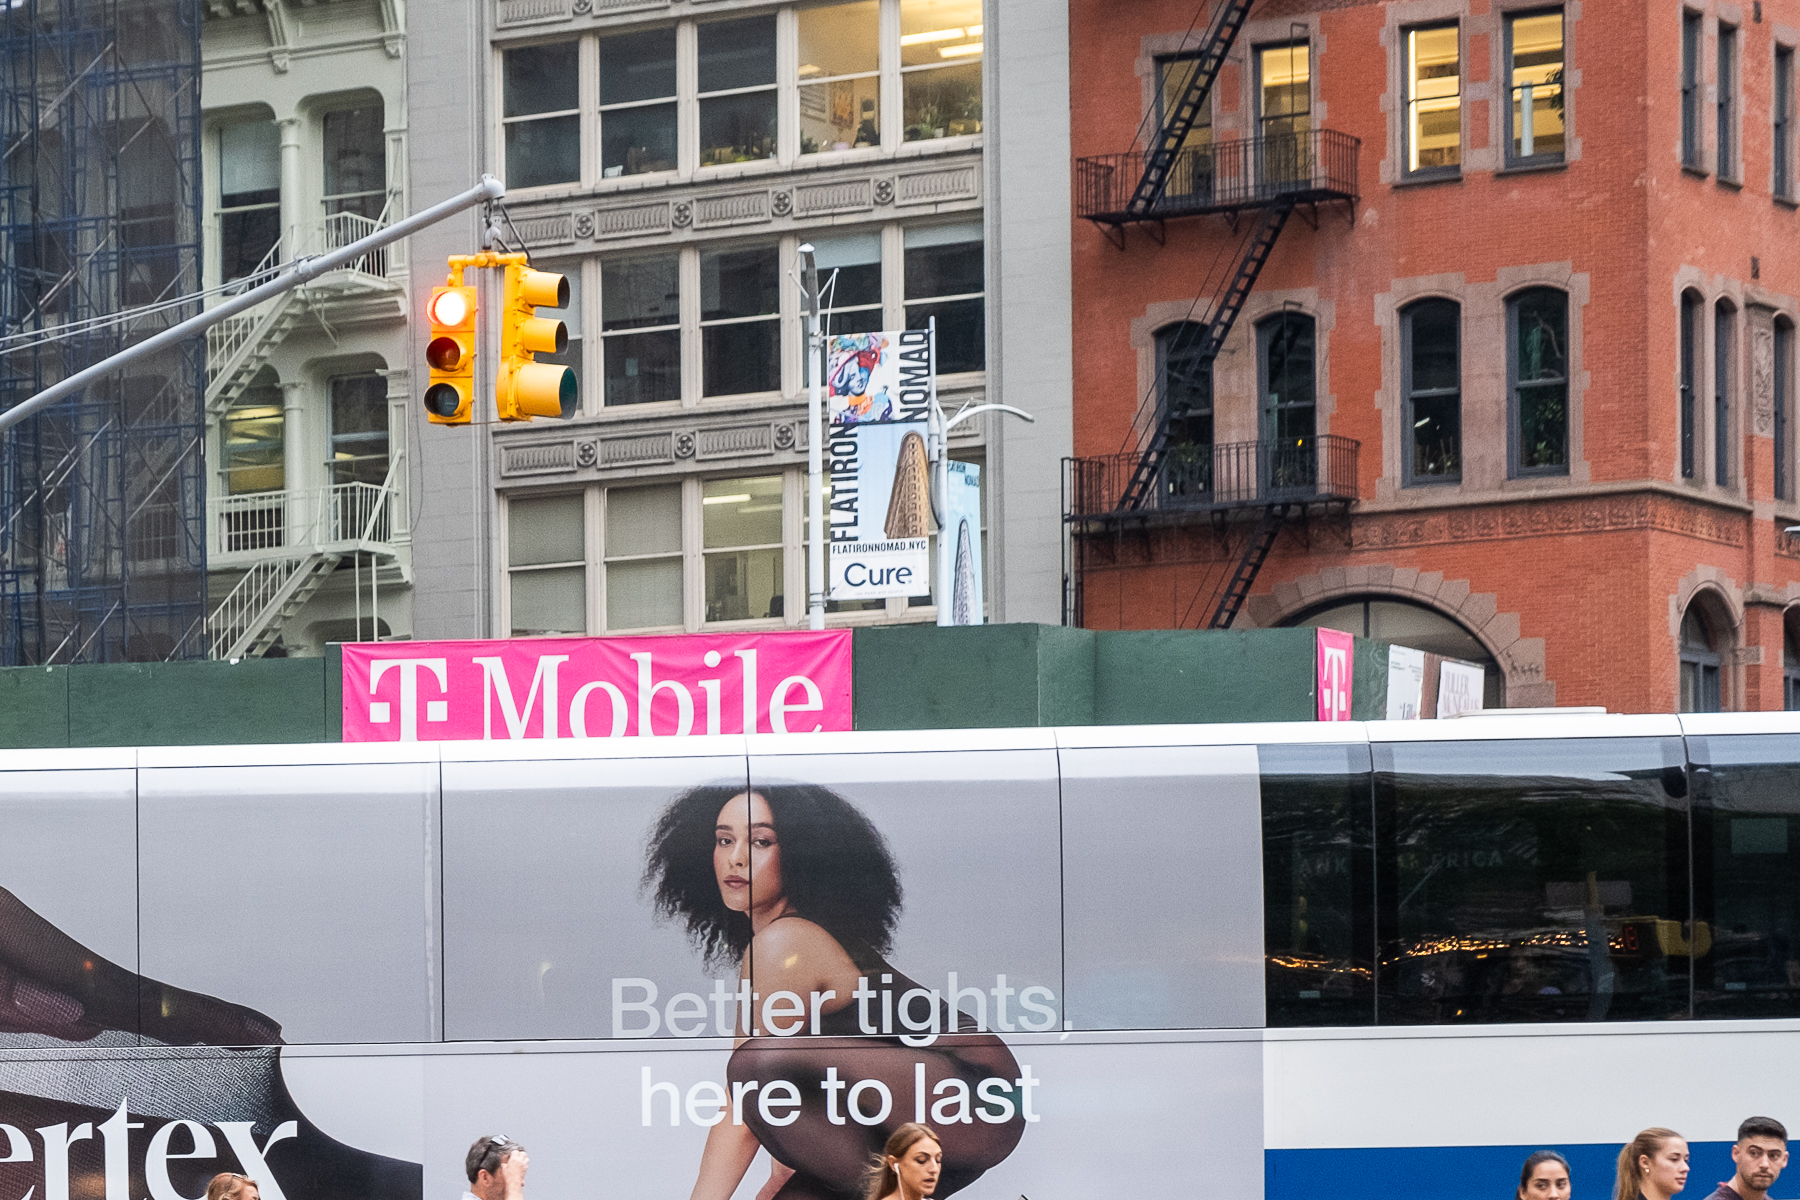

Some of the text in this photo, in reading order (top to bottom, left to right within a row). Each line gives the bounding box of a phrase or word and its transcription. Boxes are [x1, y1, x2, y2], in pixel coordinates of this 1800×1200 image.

[899, 328, 929, 422] NOMAD
[830, 421, 858, 542] FLATIRON
[832, 540, 927, 554] FLATIRONNOMAD.NYC
[472, 648, 824, 740] Mobile
[611, 972, 1074, 1047] Better tights,
[641, 1062, 1041, 1127] here to last
